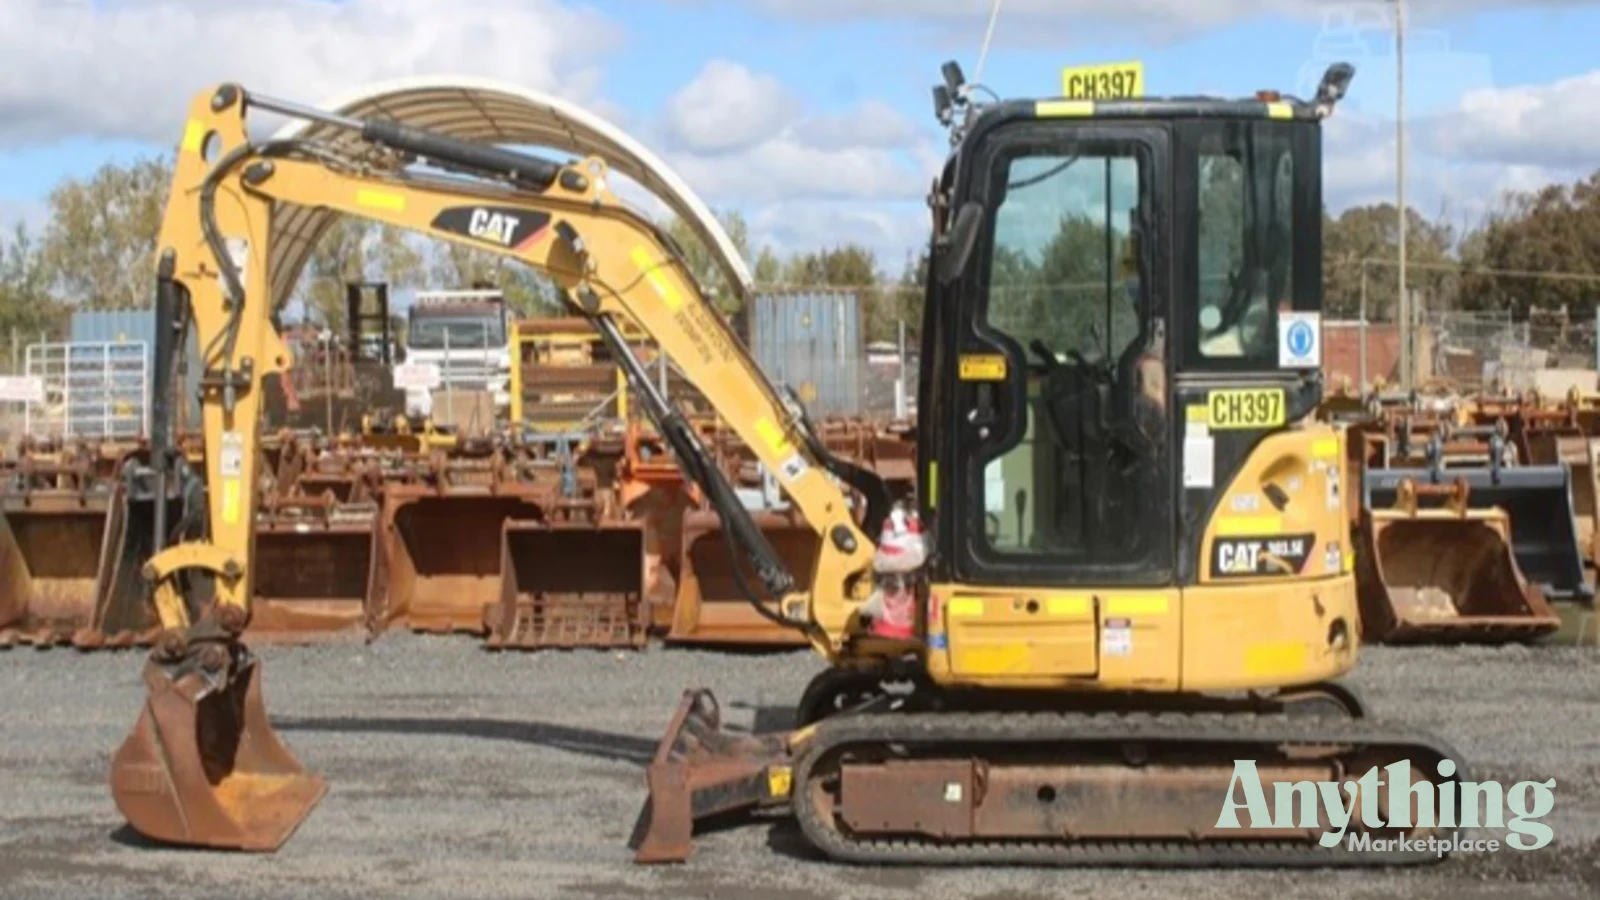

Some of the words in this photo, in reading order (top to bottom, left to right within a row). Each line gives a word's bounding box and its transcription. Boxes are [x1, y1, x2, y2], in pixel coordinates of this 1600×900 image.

[1069, 69, 1137, 99] CH397
[468, 207, 520, 246] CAT
[1213, 392, 1281, 425] CH397
[1218, 541, 1262, 574] CAT
